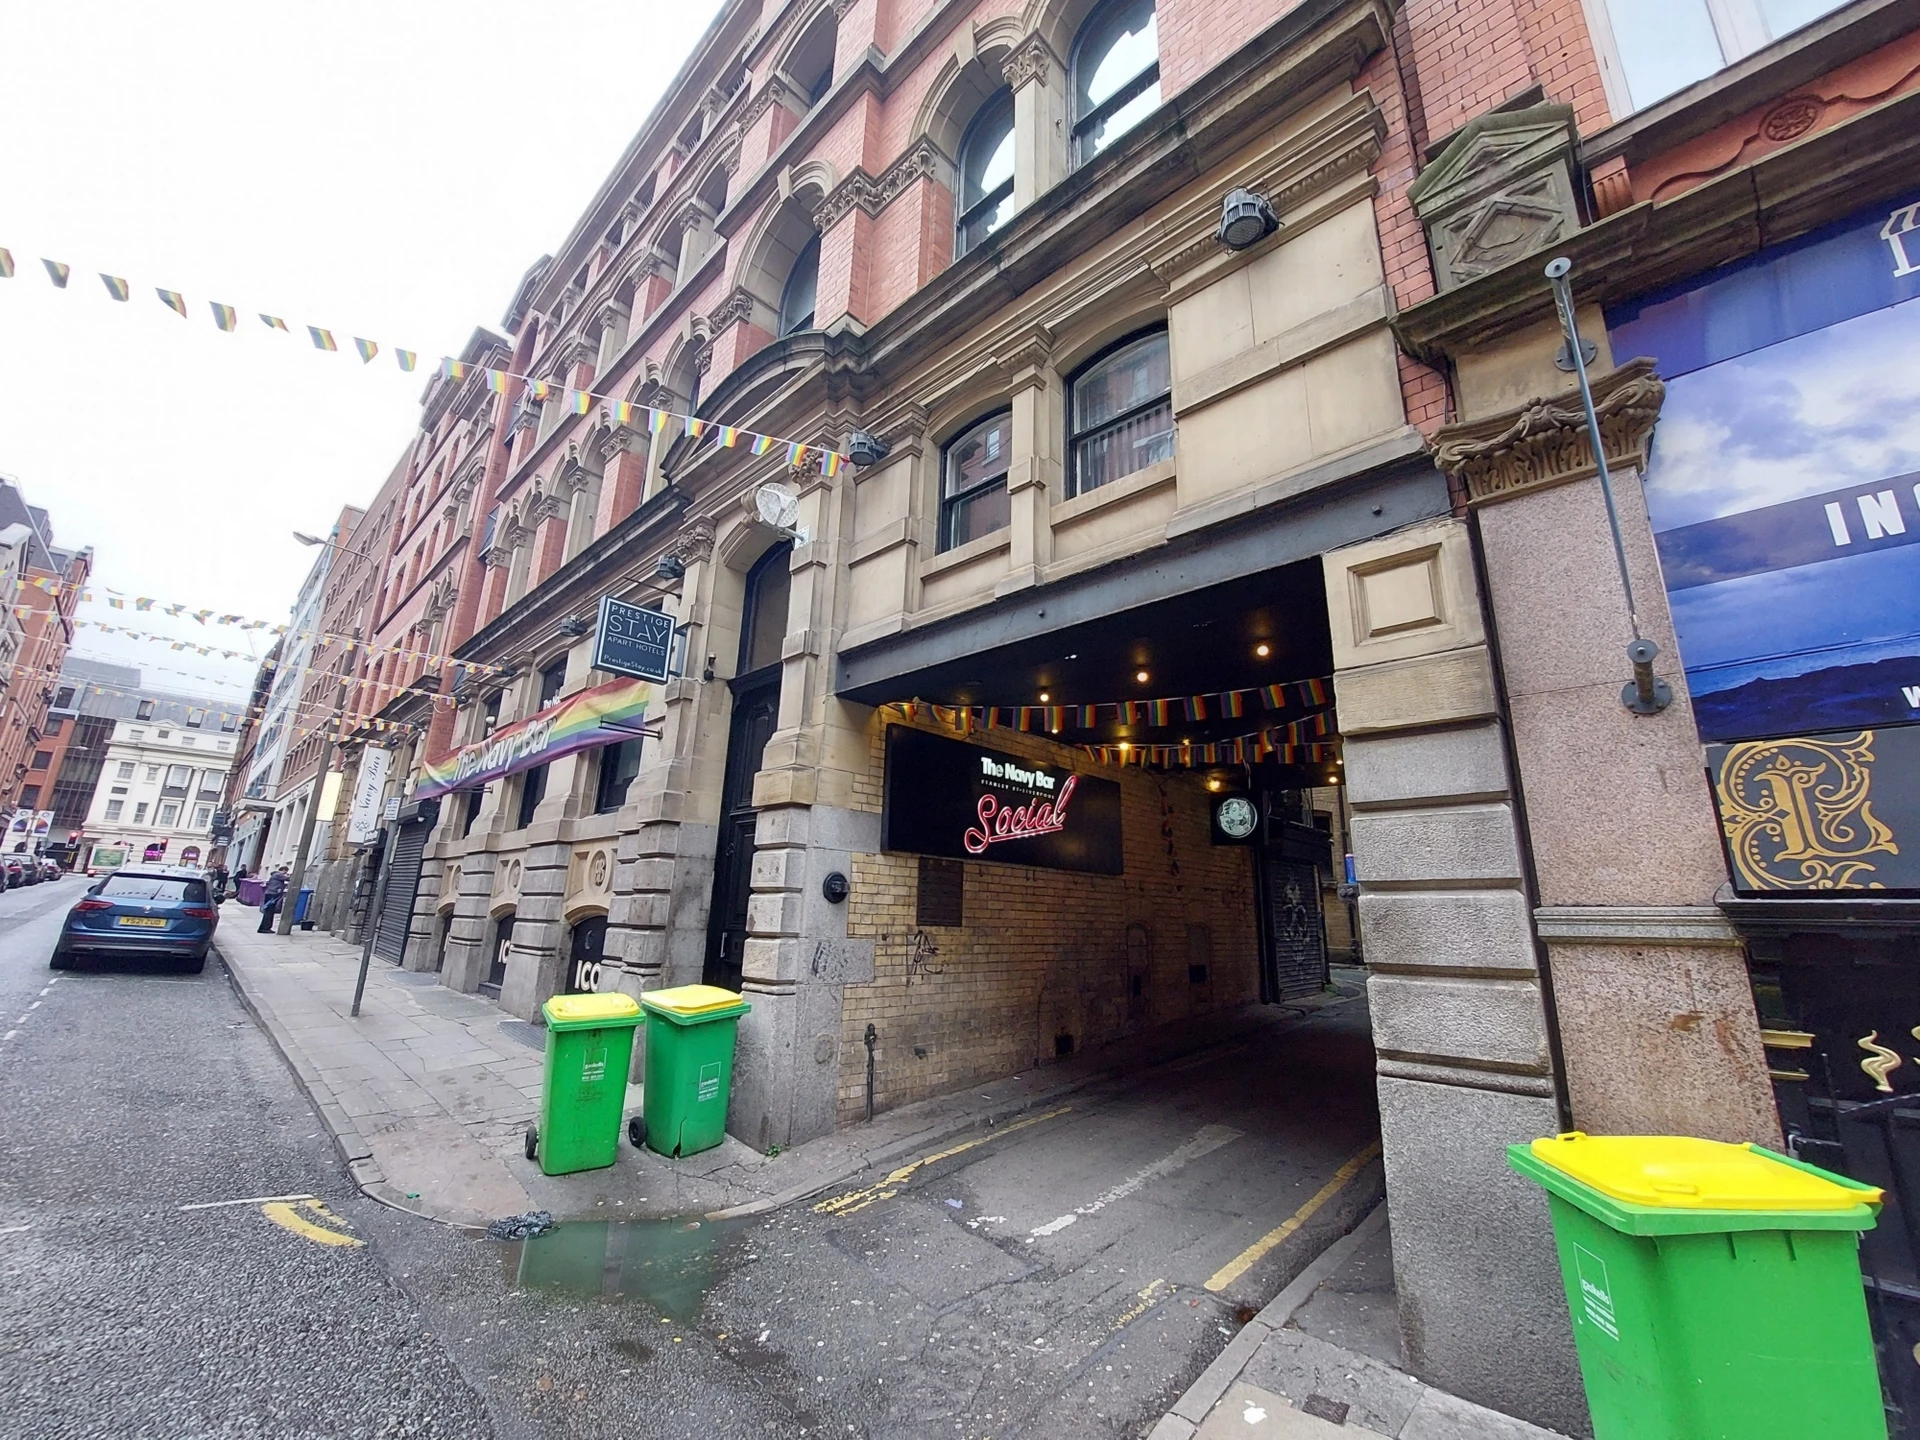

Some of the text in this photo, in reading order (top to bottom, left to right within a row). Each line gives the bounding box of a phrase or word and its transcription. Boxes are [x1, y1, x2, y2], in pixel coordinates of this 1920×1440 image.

[609, 614, 667, 644] STAY
[611, 604, 669, 629] PRESTIGE
[607, 635, 665, 657] APART HOTELS
[453, 716, 557, 781] The Navy Bar
[367, 755, 381, 781] Bar
[981, 757, 1055, 789] The Navy Bar
[981, 779, 1009, 789] STANLEY
[359, 783, 379, 817] Navy
[964, 775, 1077, 853] Social
